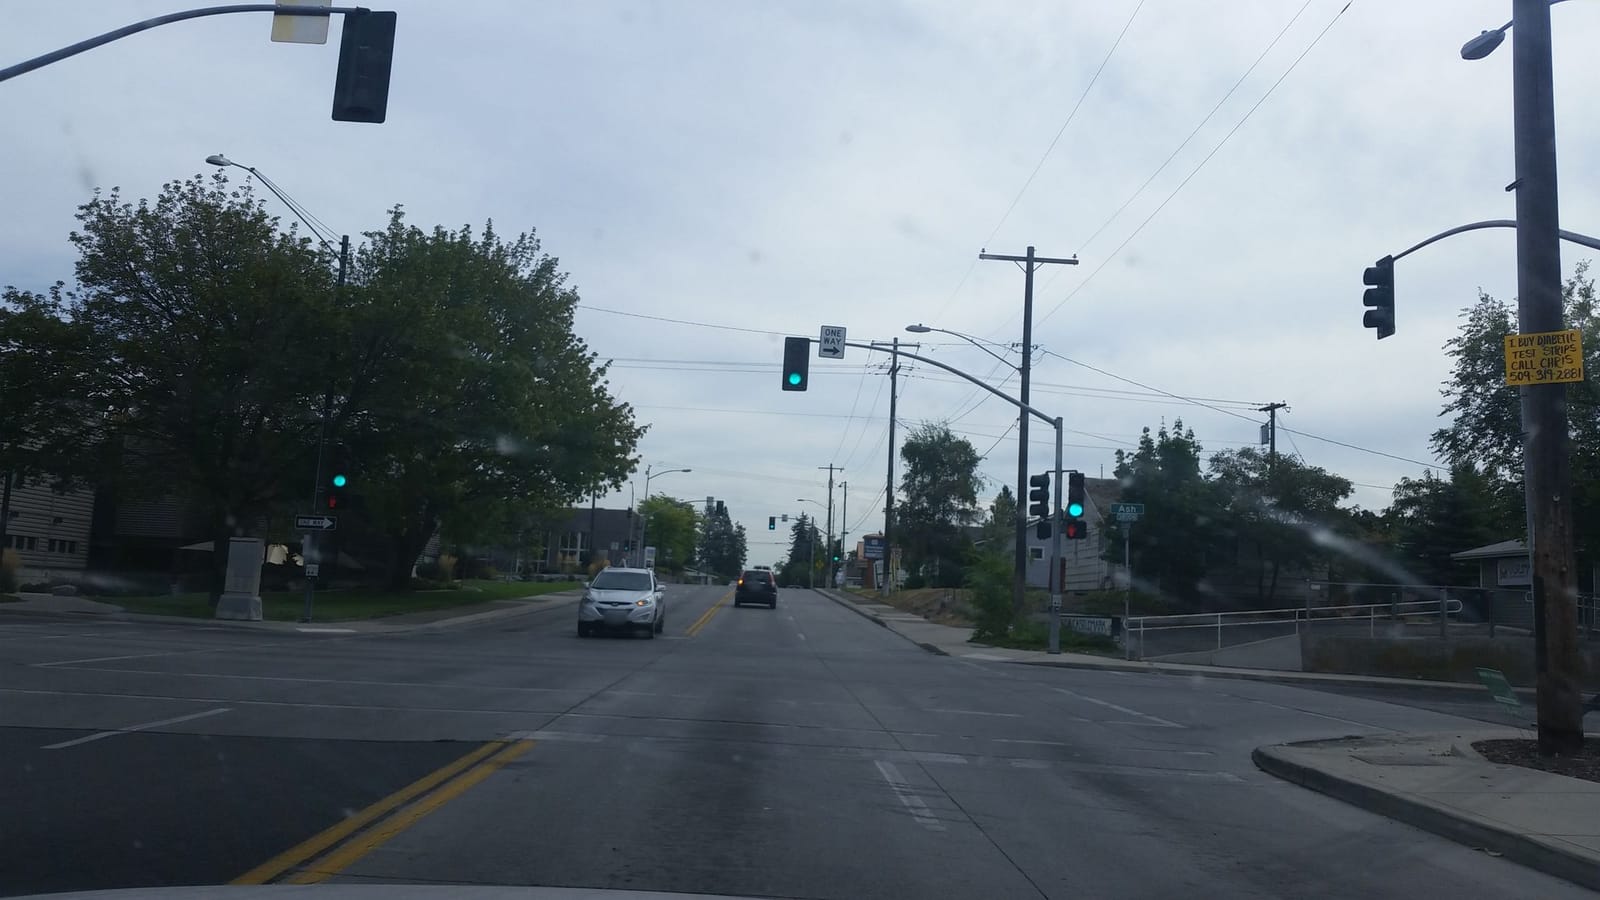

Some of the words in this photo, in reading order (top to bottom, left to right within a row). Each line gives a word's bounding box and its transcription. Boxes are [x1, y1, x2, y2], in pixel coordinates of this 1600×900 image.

[825, 329, 841, 337] ONE
[824, 337, 841, 345] WAY
[1509, 339, 1517, 347] I
[1518, 336, 1535, 347] BUY
[1537, 333, 1576, 346] DIABETIC
[1512, 350, 1536, 359] TEST
[1543, 344, 1577, 356] STRIPS
[1511, 360, 1536, 370] CALL
[1540, 355, 1574, 368] CHRIS
[1118, 504, 1136, 513] Ash
